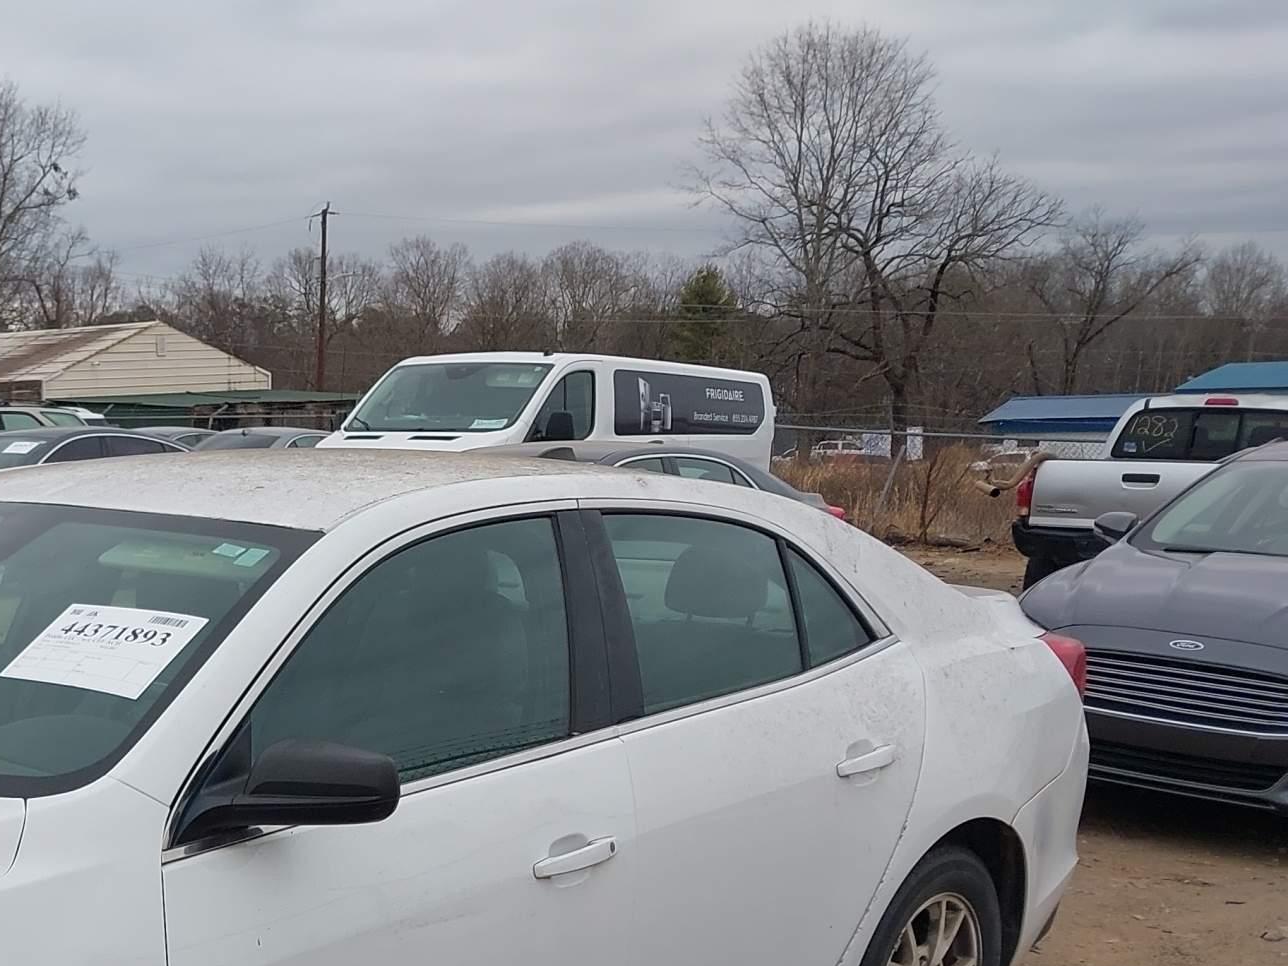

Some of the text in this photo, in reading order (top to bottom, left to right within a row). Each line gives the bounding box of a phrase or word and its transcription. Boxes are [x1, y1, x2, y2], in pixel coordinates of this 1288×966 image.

[705, 388, 745, 401] FRIGIDAIRE
[1129, 415, 1179, 438] 1282
[61, 621, 174, 647] 44371893
